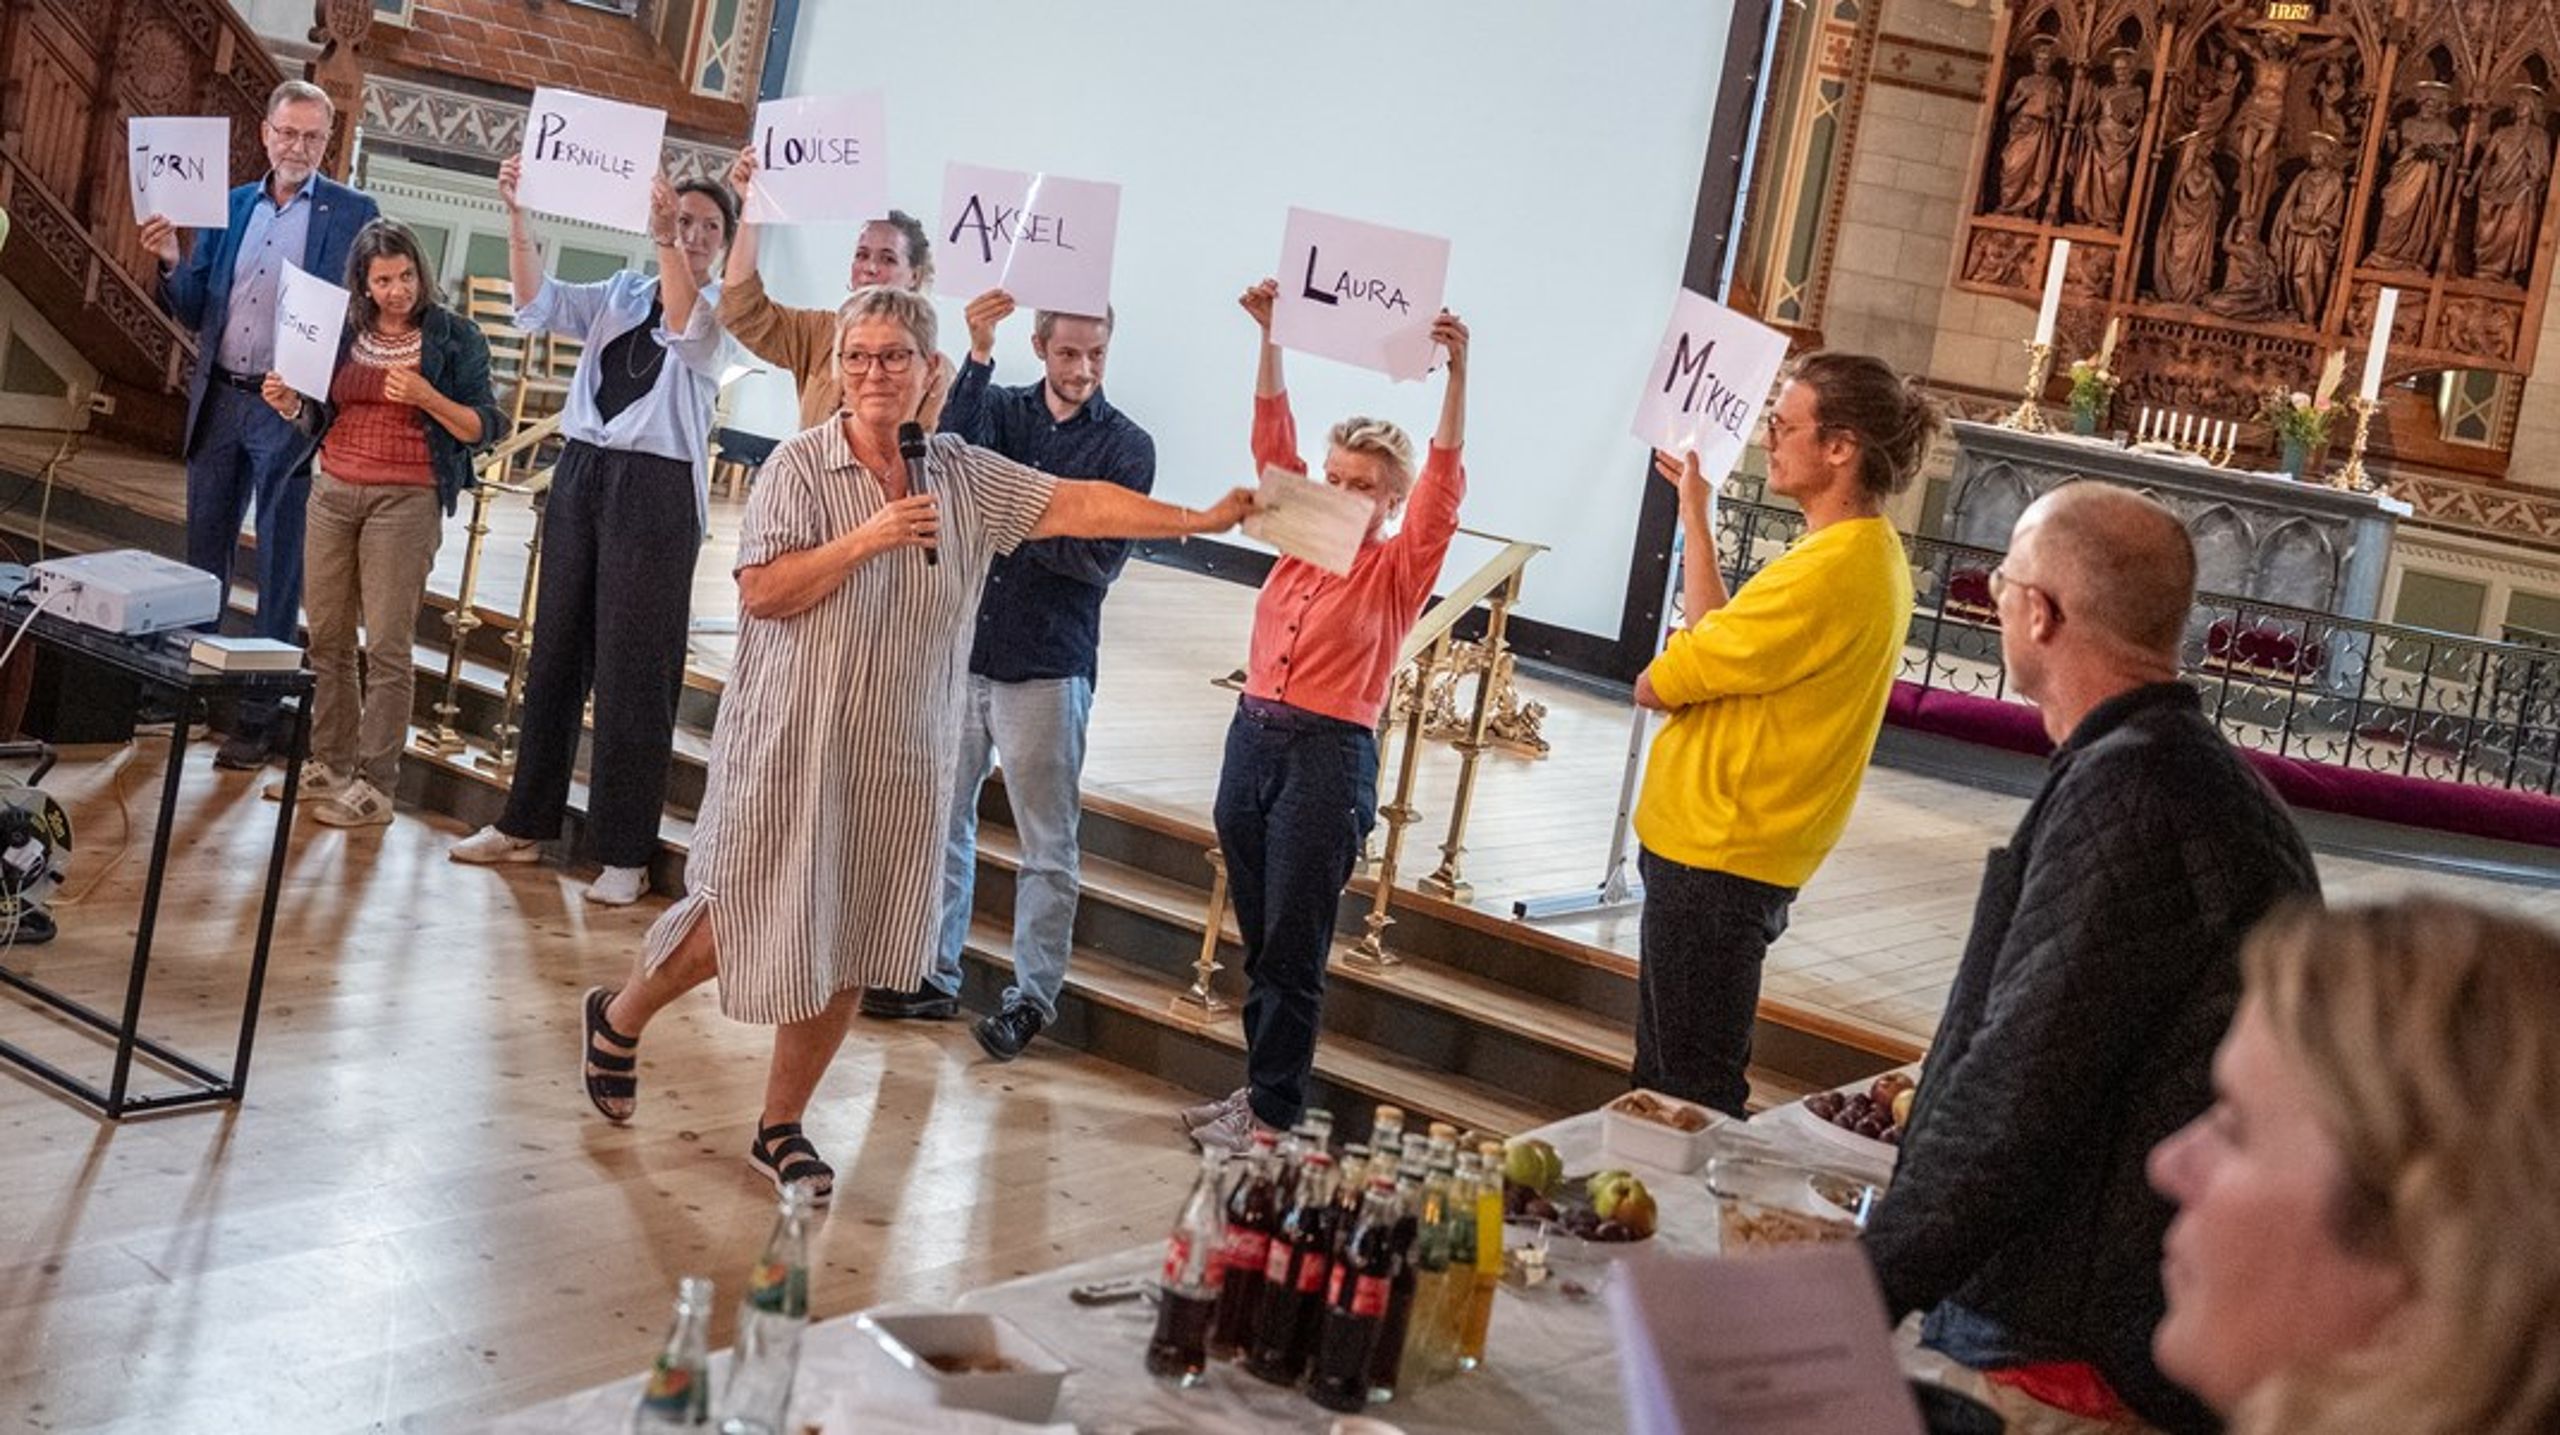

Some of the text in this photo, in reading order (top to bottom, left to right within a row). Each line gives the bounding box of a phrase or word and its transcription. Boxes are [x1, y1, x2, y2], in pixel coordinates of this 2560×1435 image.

[136, 145, 204, 192] JØRN
[949, 194, 1076, 263] AKSEL
[1303, 245, 1410, 315] LAURA
